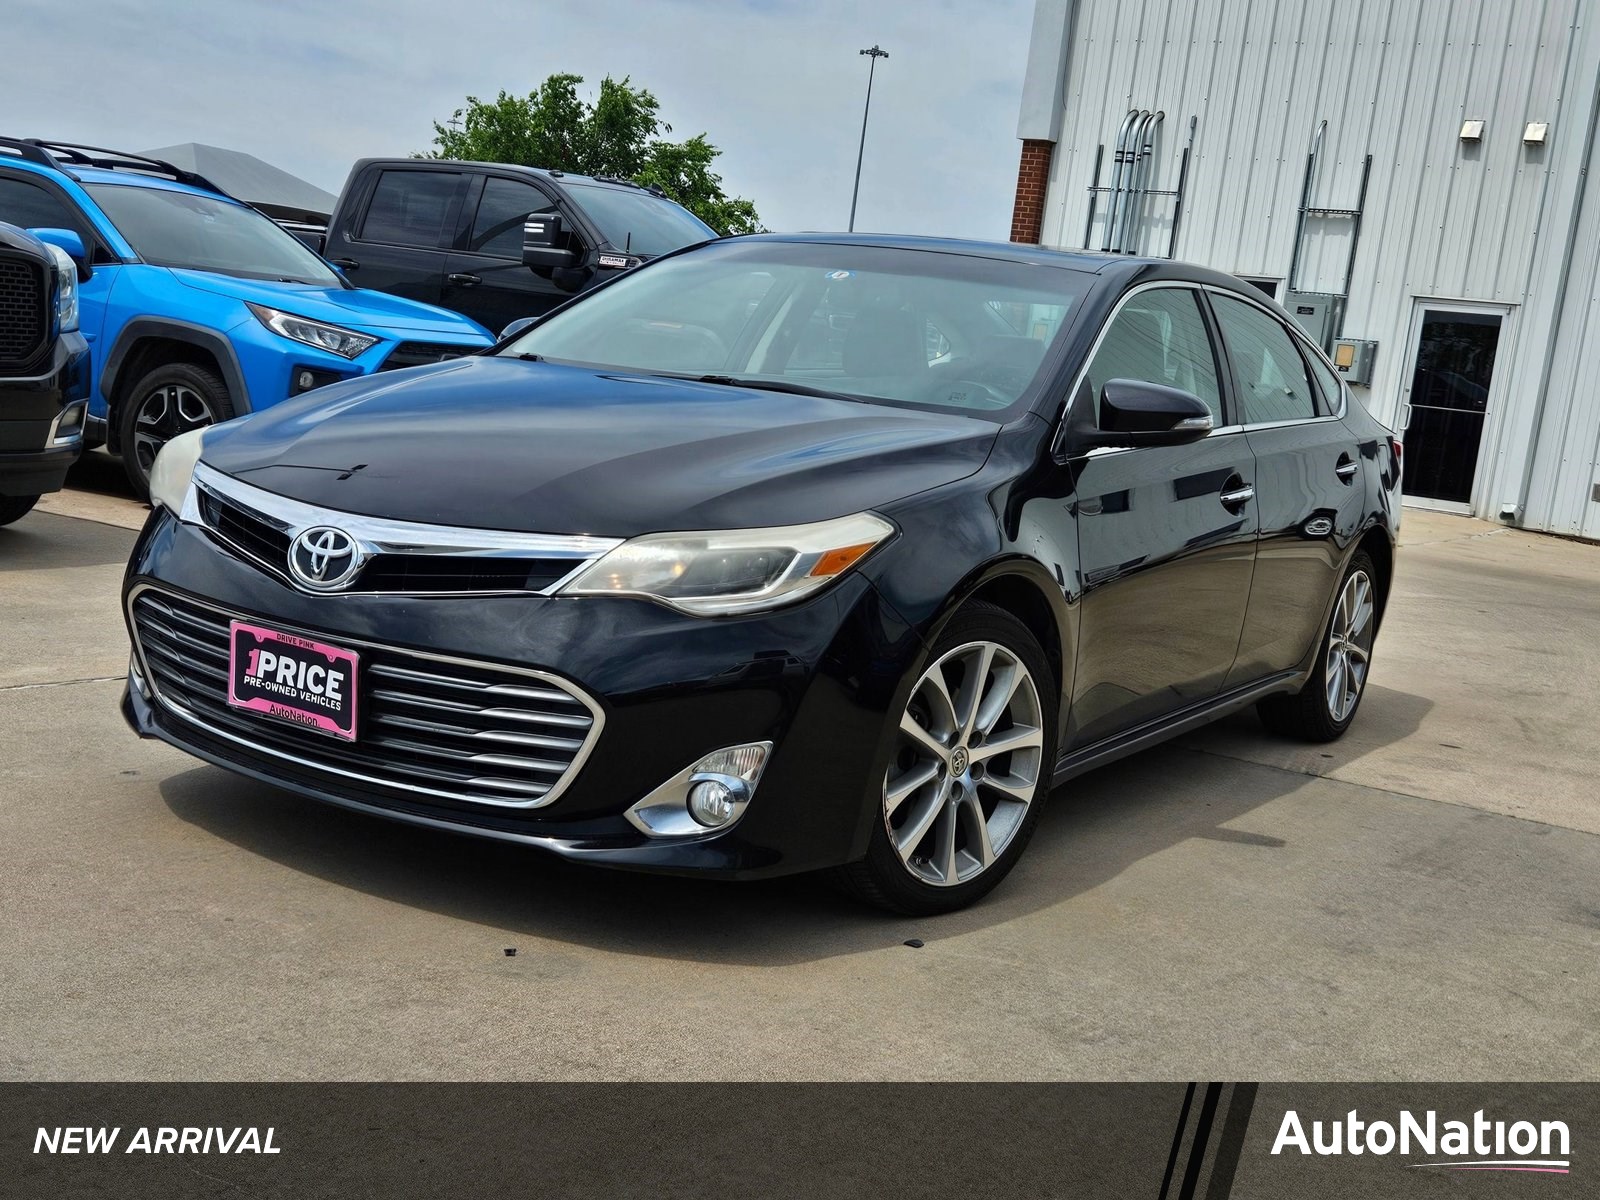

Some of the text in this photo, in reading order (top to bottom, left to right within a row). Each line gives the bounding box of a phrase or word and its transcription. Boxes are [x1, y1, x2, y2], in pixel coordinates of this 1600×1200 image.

[276, 633, 315, 650] DRIVE PINK
[243, 675, 342, 711] PRE-OWNED VEHICLES
[269, 703, 319, 727] AutoNation
